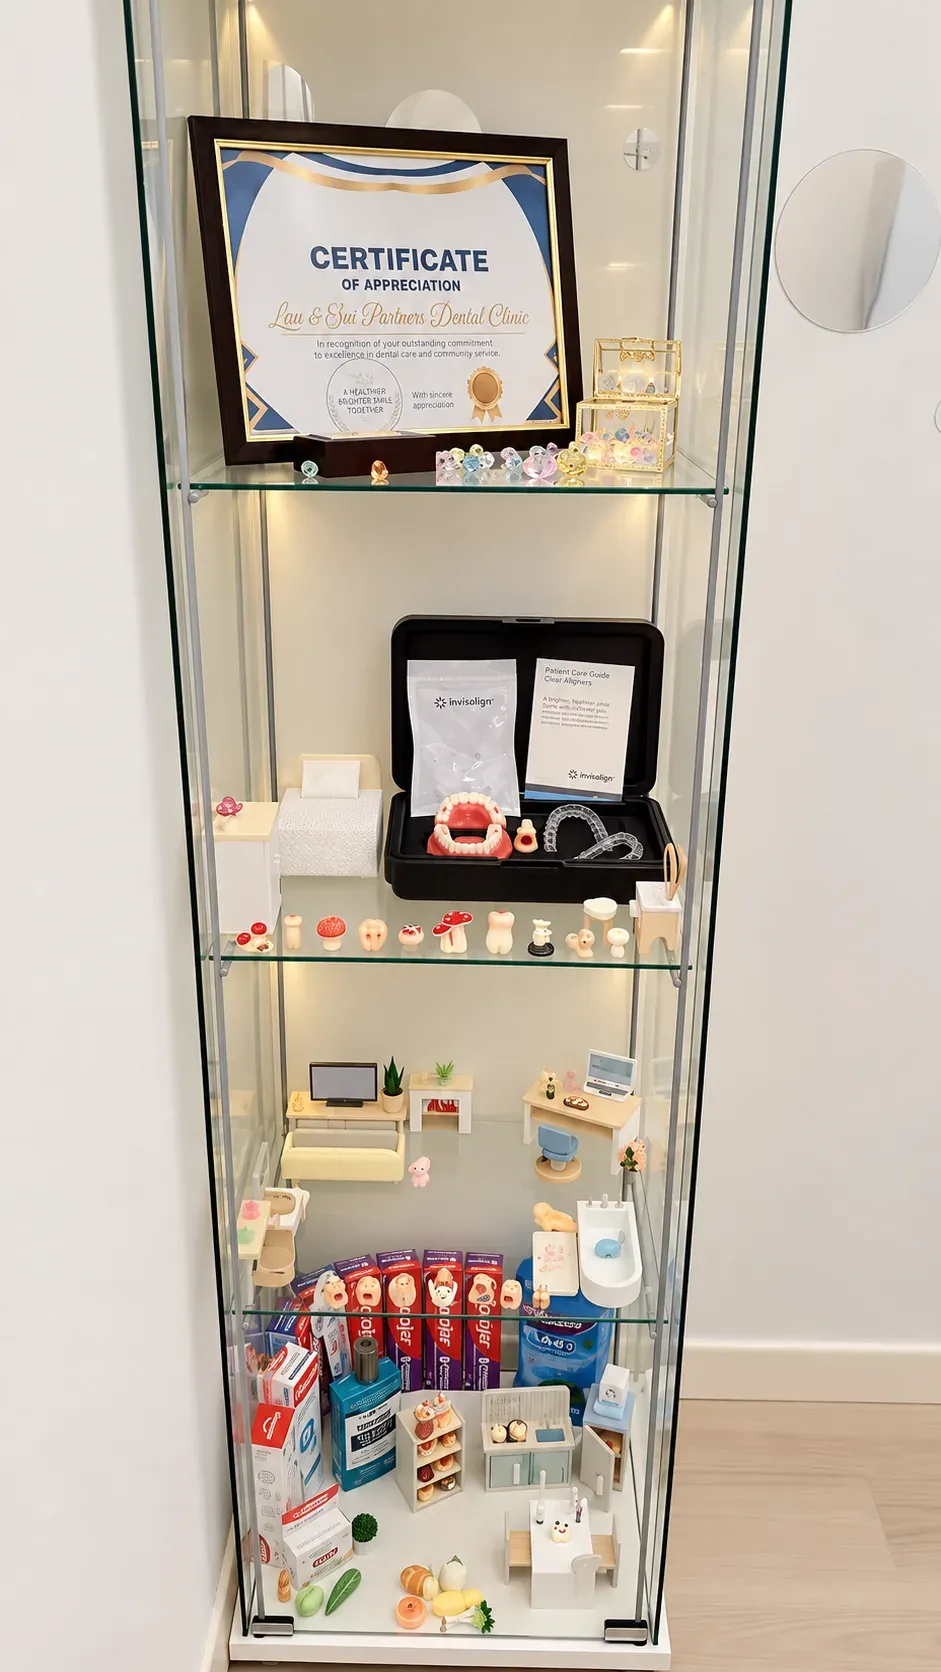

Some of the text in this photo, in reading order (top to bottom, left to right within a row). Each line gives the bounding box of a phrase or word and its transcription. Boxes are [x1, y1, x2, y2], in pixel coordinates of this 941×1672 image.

[310, 246, 489, 272] CERTIFICATE
[341, 278, 461, 292] OF APPRECIATION
[268, 301, 304, 332] Lau
[308, 307, 323, 326] &
[361, 300, 425, 327] Partners
[430, 300, 485, 327] Dental
[488, 302, 531, 327] Clinic
[316, 339, 493, 349] In recognition of your outstanding commitment
[314, 351, 323, 359] to
[324, 351, 365, 359] excellence
[366, 351, 374, 359] in
[375, 350, 399, 359] dental
[418, 350, 432, 358] and
[412, 390, 453, 399] With sincere
[545, 666, 570, 676] Patient
[564, 677, 592, 686] Aligners
